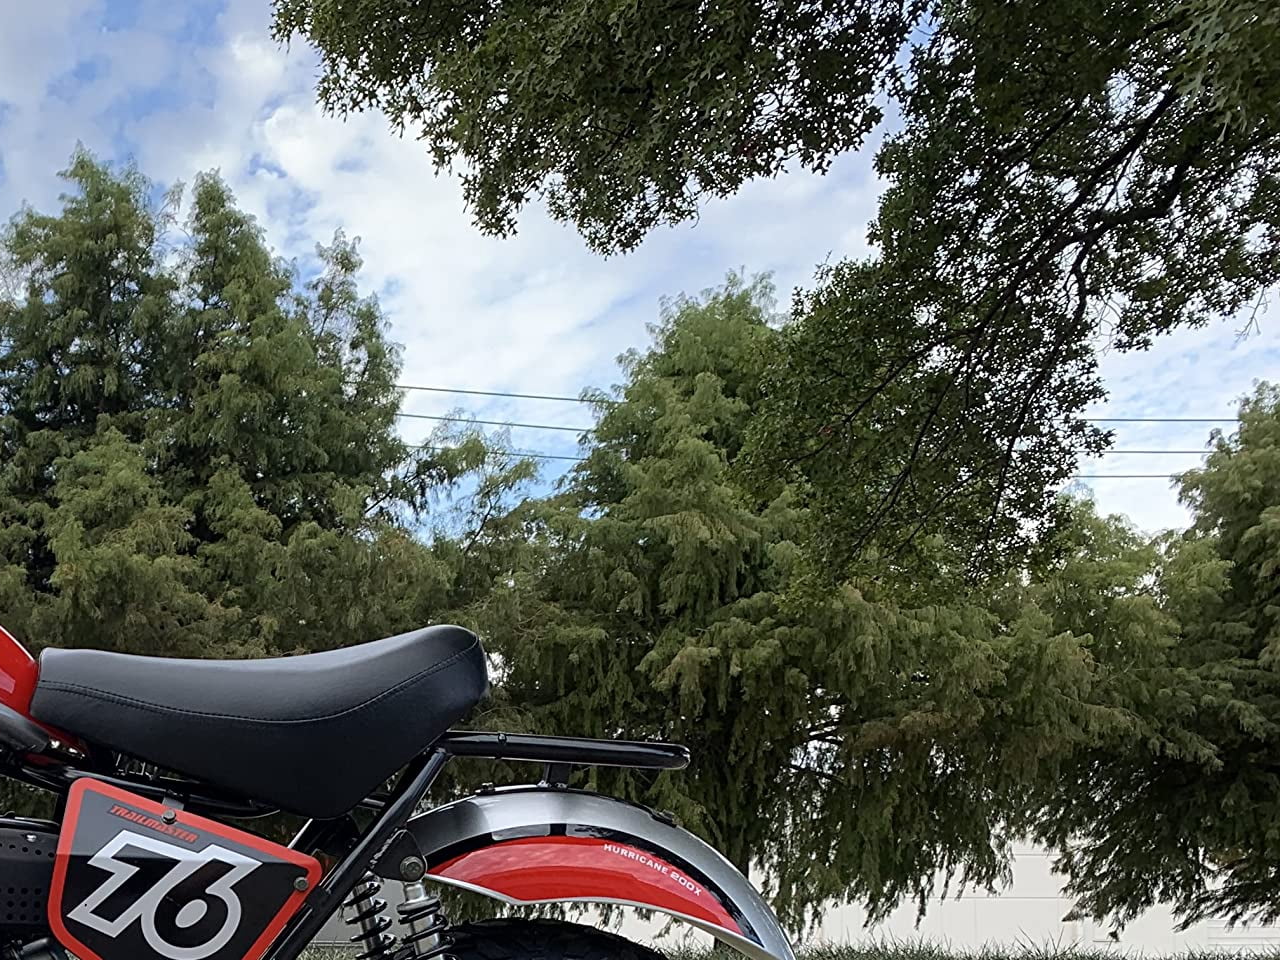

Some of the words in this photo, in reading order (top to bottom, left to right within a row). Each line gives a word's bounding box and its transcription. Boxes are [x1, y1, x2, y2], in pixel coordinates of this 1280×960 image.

[109, 804, 199, 843] TRAILMASTER
[66, 829, 263, 960] 76
[603, 843, 669, 875] HURRICANE
[670, 871, 702, 897] 200X
